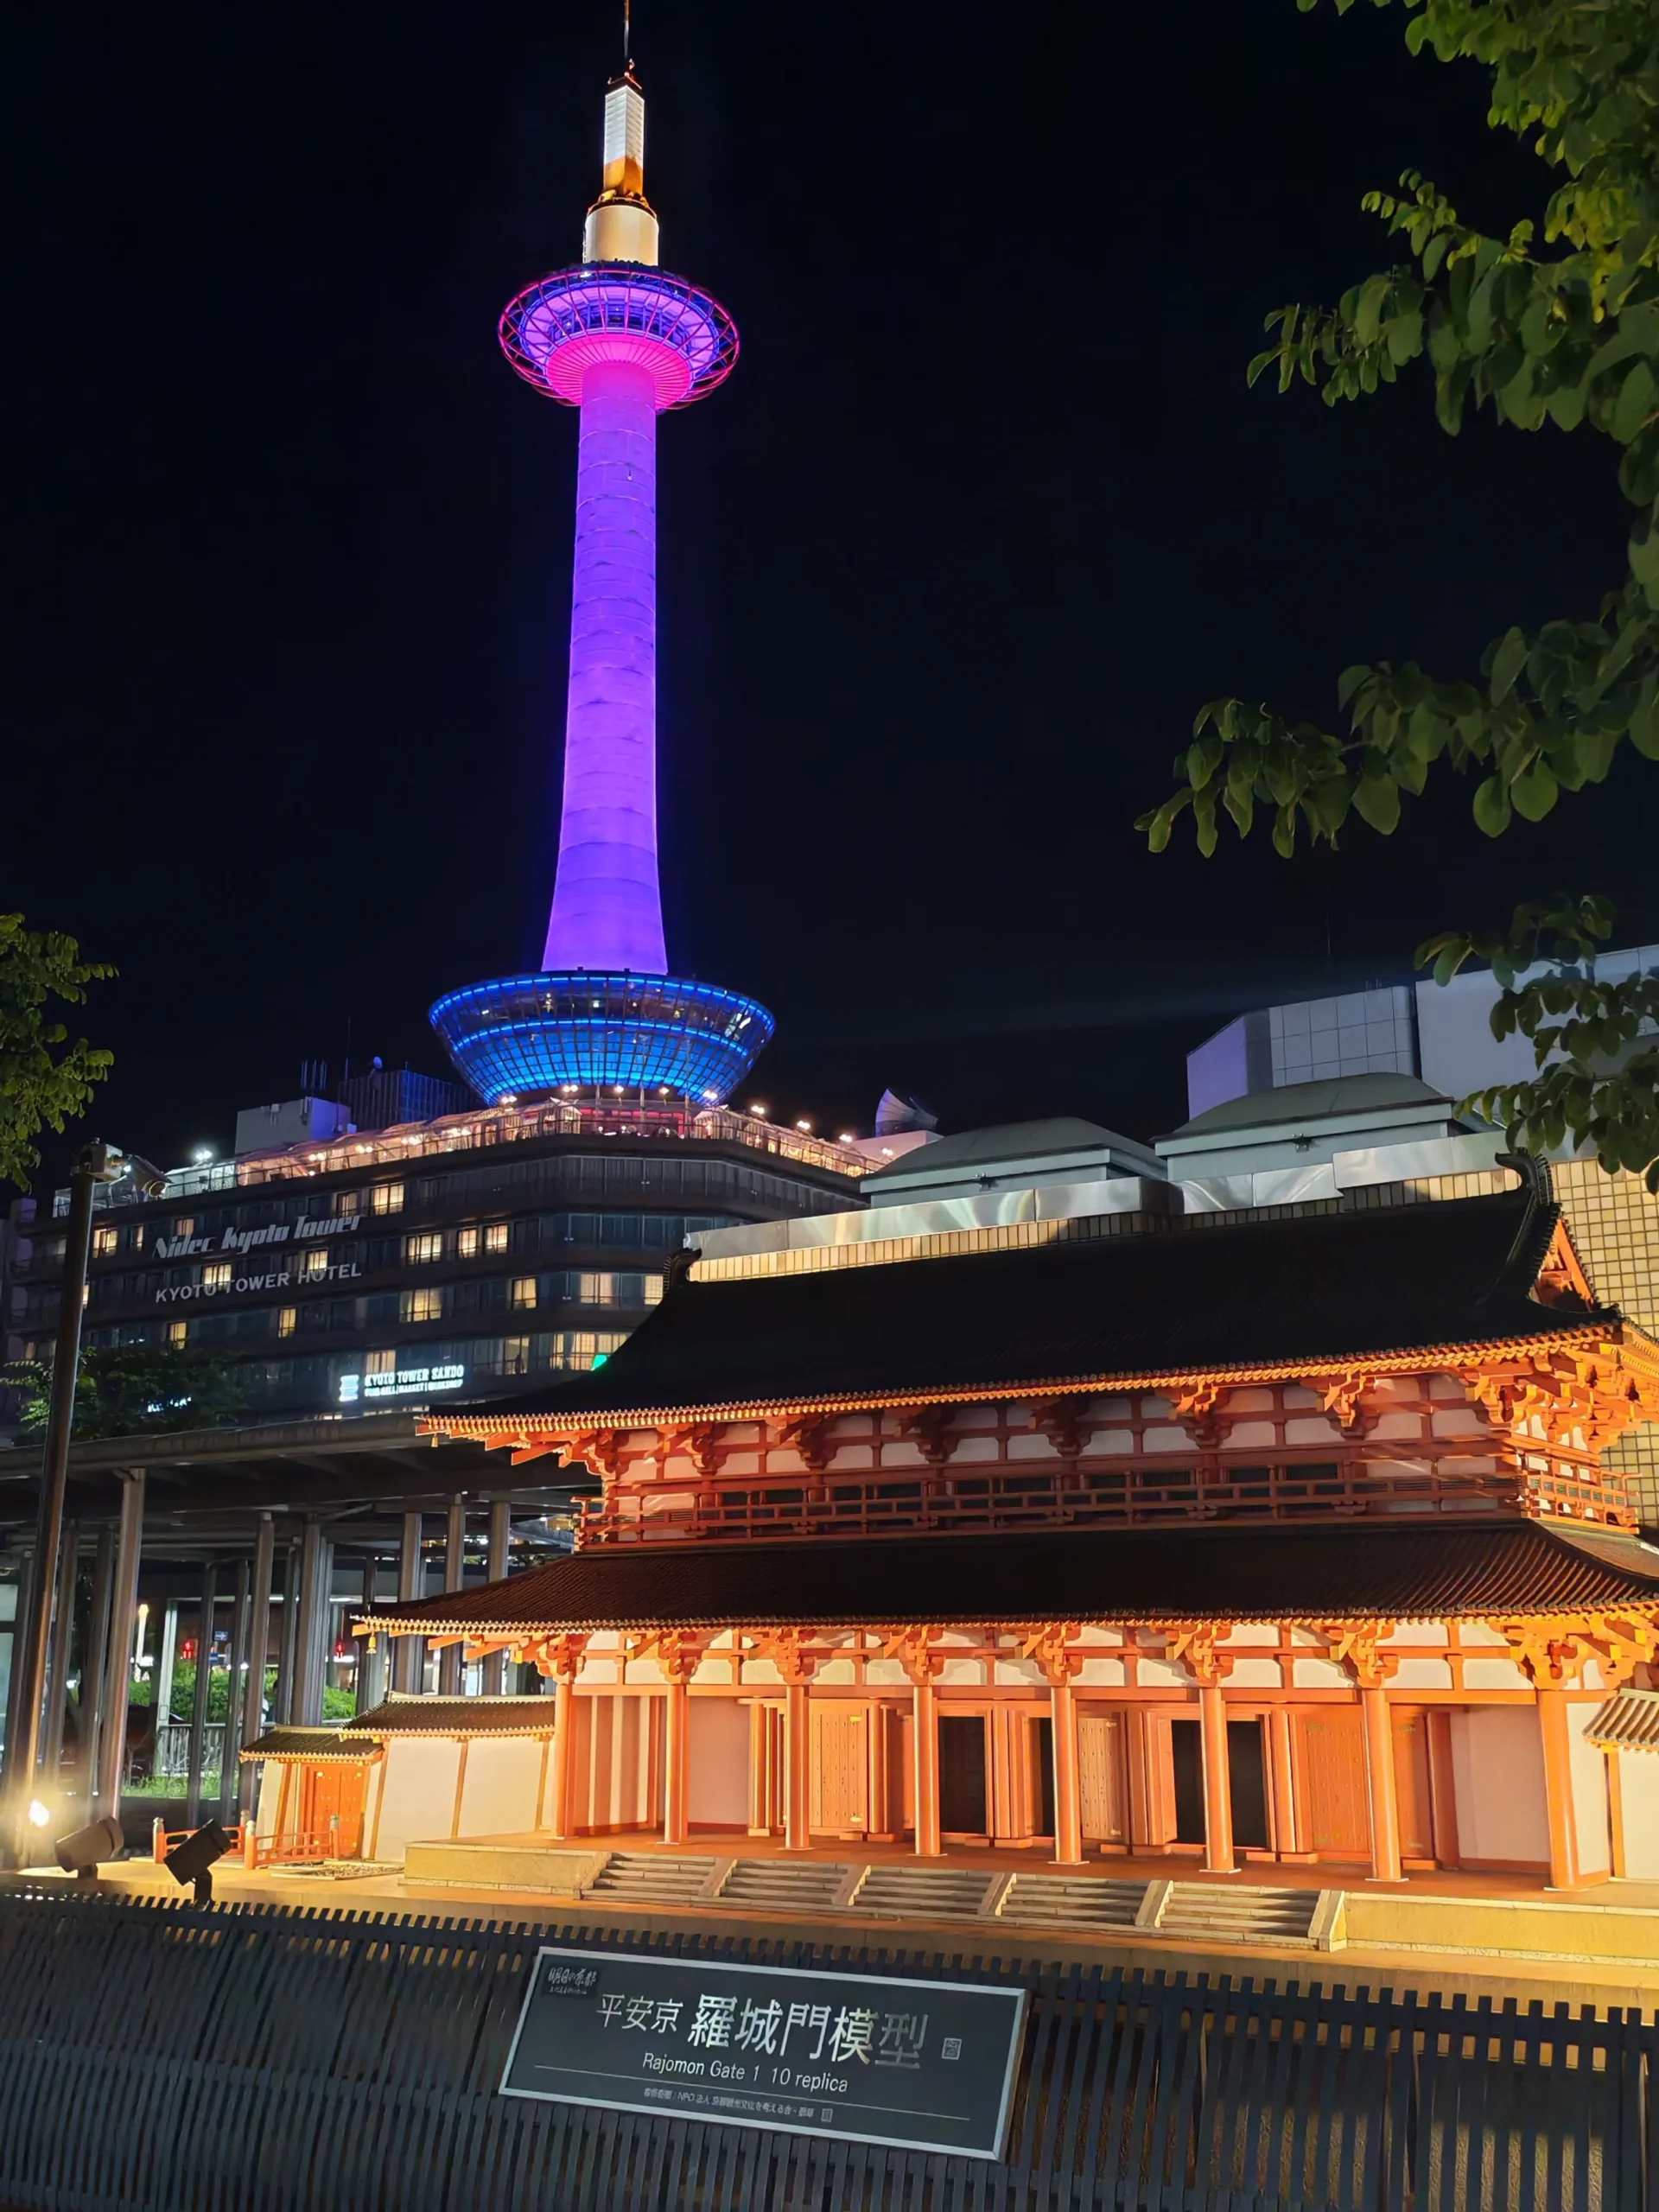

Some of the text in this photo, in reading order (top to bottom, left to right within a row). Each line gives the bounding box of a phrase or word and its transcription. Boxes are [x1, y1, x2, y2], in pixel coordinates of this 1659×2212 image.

[154, 1214, 361, 1259] Nidec Kyoto Tower
[156, 1262, 362, 1303] KYOTO TOWER HOTEL
[364, 1364, 465, 1387] KYOTO TOWER SANDO
[596, 1993, 929, 2070] 平安京 羅城門模型
[642, 2052, 705, 2076] Rajomon
[709, 2060, 746, 2082] Gate
[794, 2071, 849, 2094] replica
